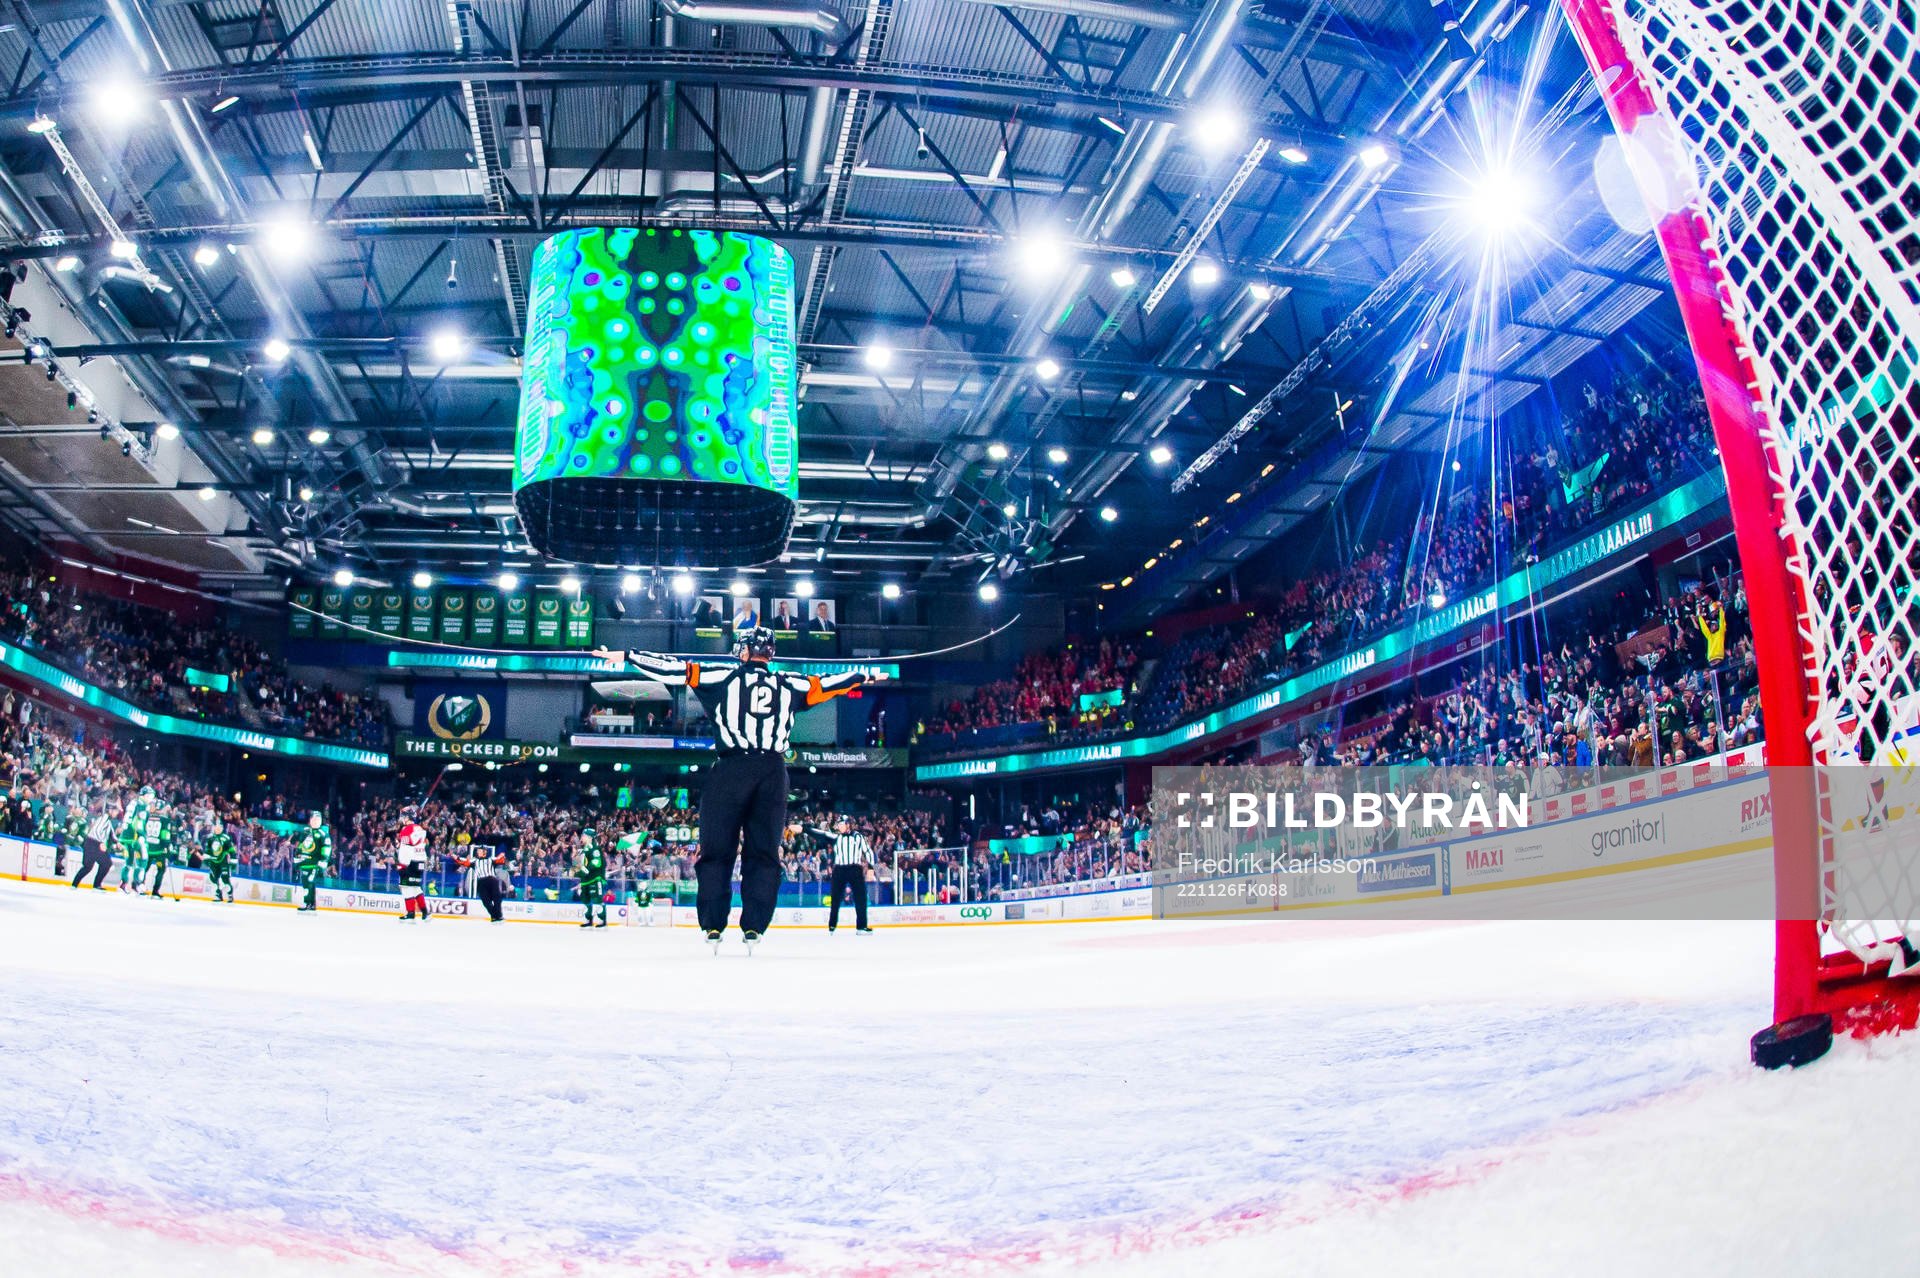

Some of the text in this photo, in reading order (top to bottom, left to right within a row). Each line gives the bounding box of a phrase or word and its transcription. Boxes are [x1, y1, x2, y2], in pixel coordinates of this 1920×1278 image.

[750, 685, 773, 714] 12
[405, 741, 559, 757] THE LOCKER ROOM
[802, 751, 867, 764] The Wolfpack
[1591, 818, 1660, 857] granitor
[1466, 848, 1504, 870] MAXI
[1382, 862, 1432, 882] Matthiessen
[358, 895, 401, 909] Thermia
[960, 906, 992, 920] coop
